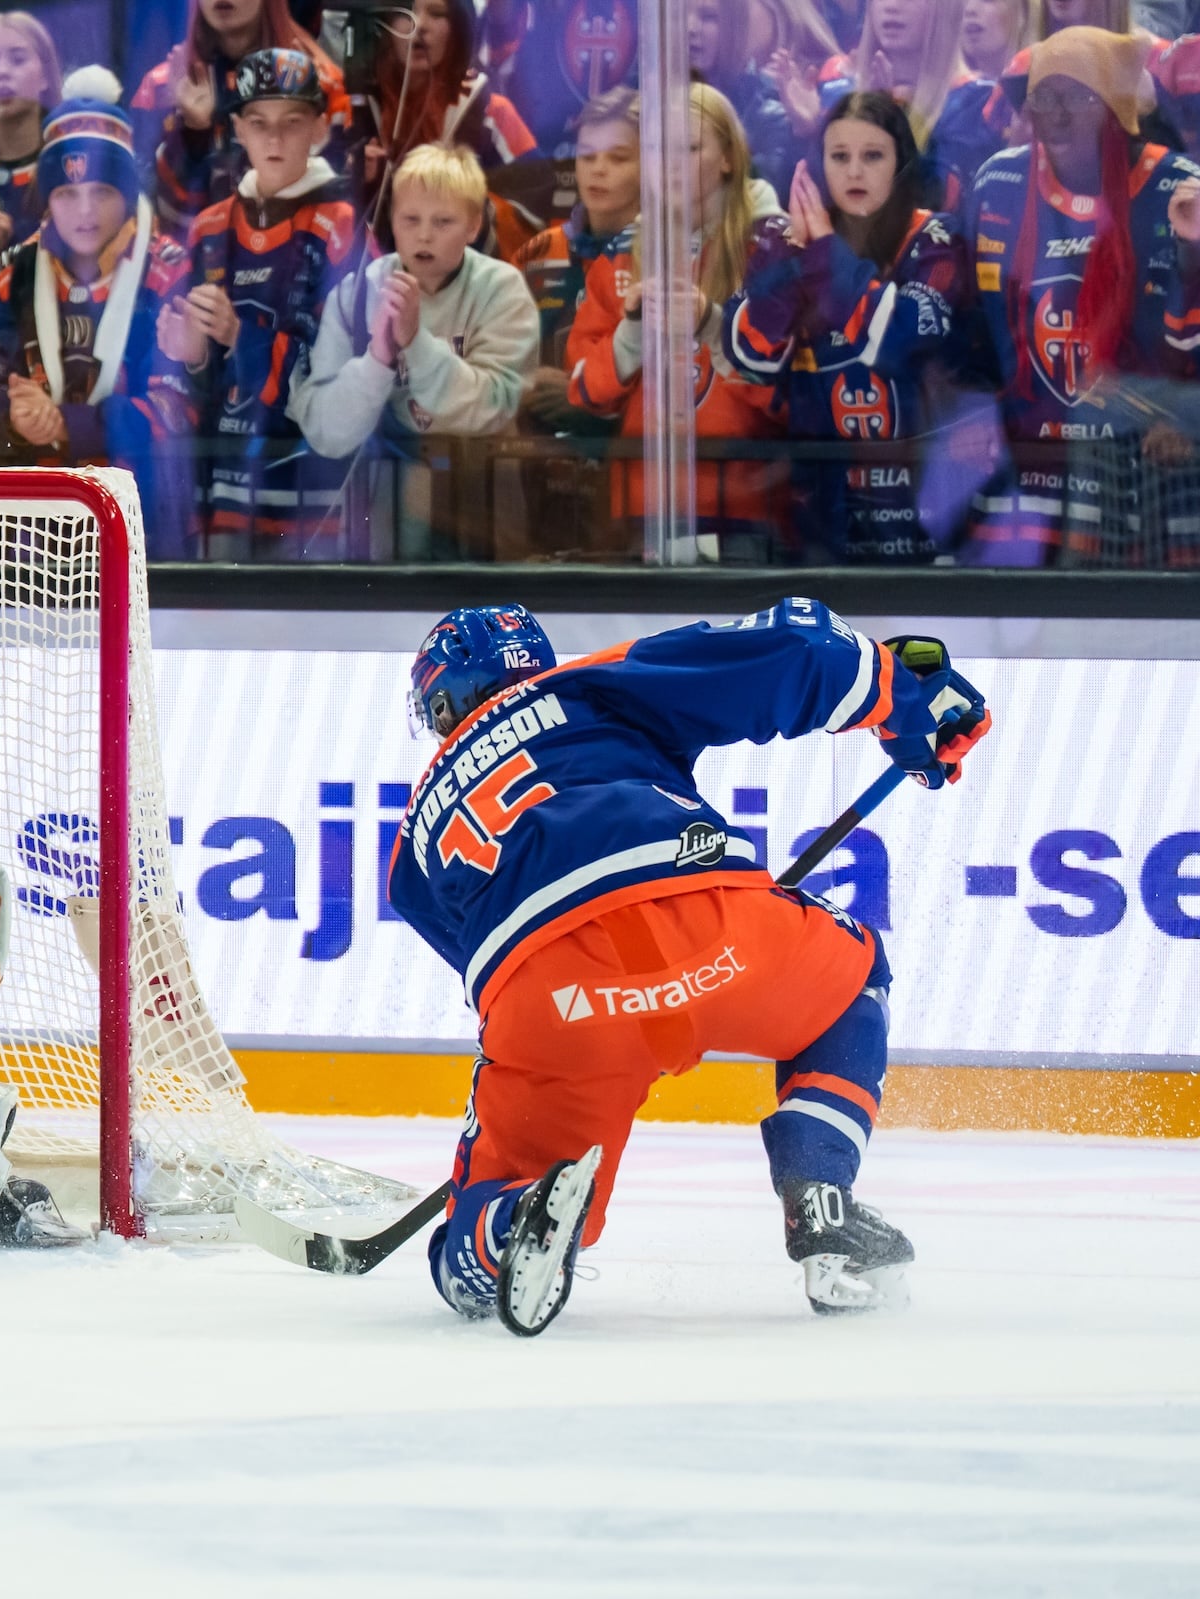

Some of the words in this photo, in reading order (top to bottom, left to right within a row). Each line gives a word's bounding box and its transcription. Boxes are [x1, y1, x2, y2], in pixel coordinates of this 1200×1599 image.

[412, 693, 568, 879] ANDERSSON
[436, 748, 559, 876] 15
[675, 827, 728, 868] Liiga
[595, 944, 747, 1016] Taratest
